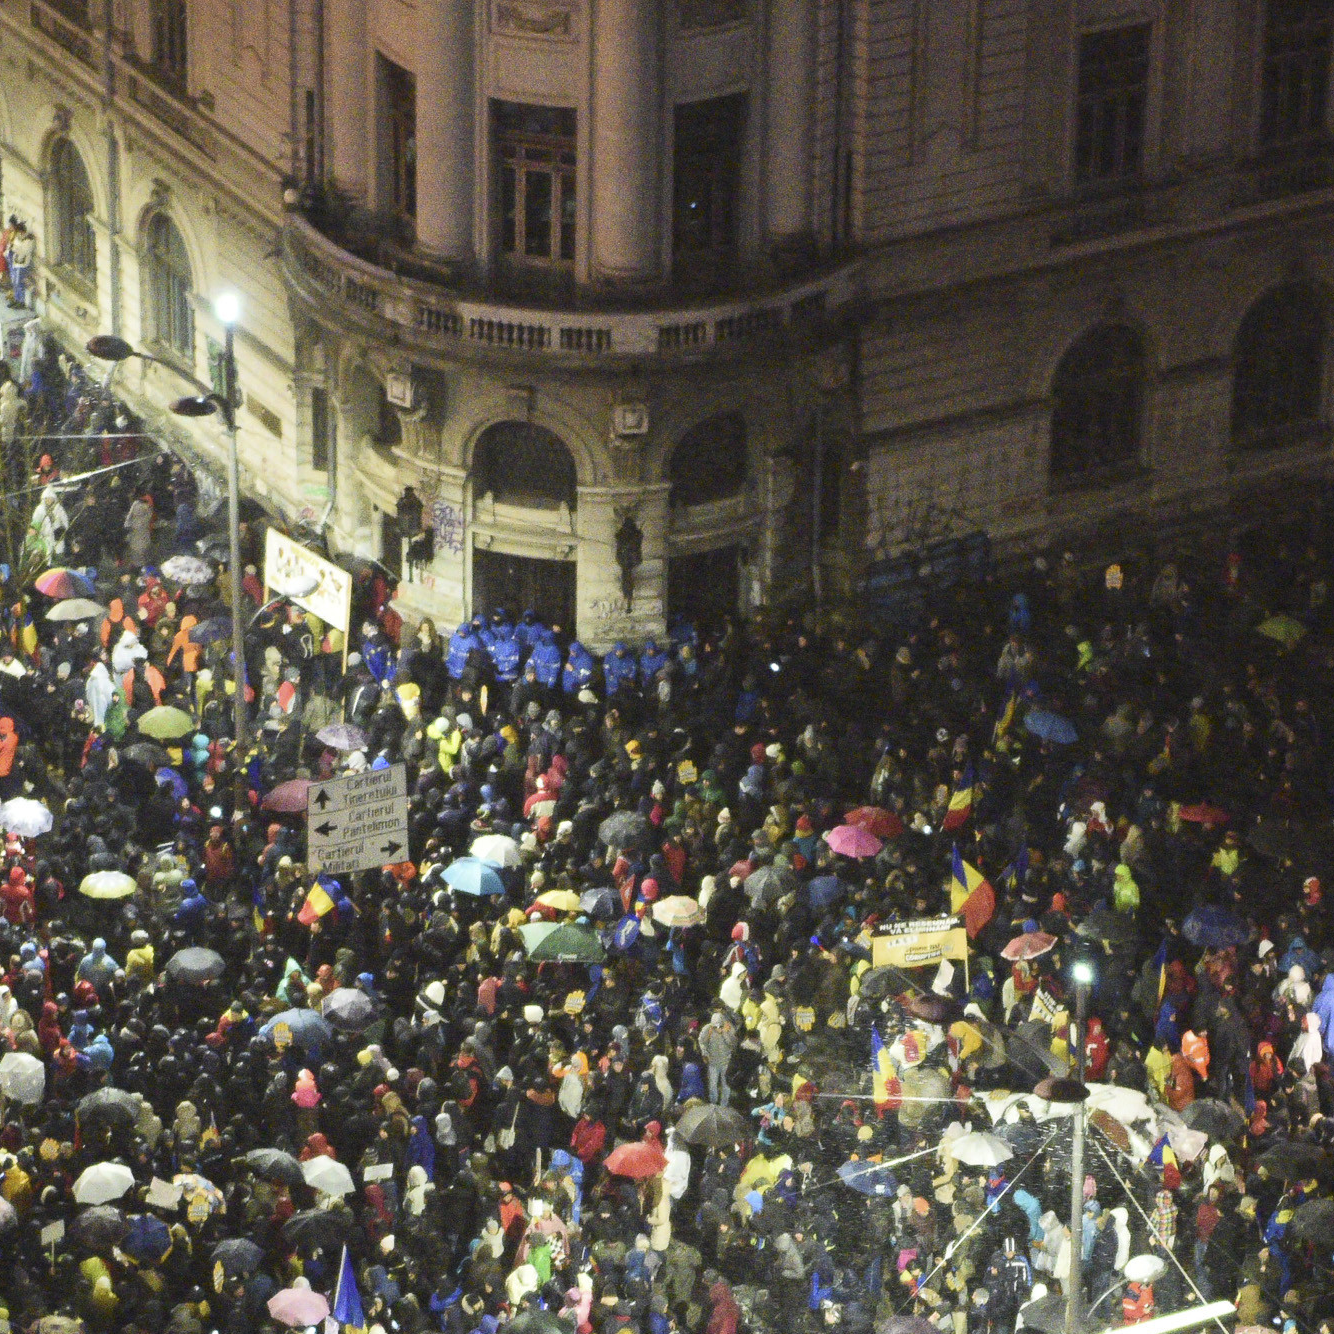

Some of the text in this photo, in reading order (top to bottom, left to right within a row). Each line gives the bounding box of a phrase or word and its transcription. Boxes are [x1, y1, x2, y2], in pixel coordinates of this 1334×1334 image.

[347, 770, 392, 790] Cartierul
[348, 803, 394, 822] Cartierul
[343, 818, 400, 839] Pantelimon
[317, 839, 364, 861] Cartierul
